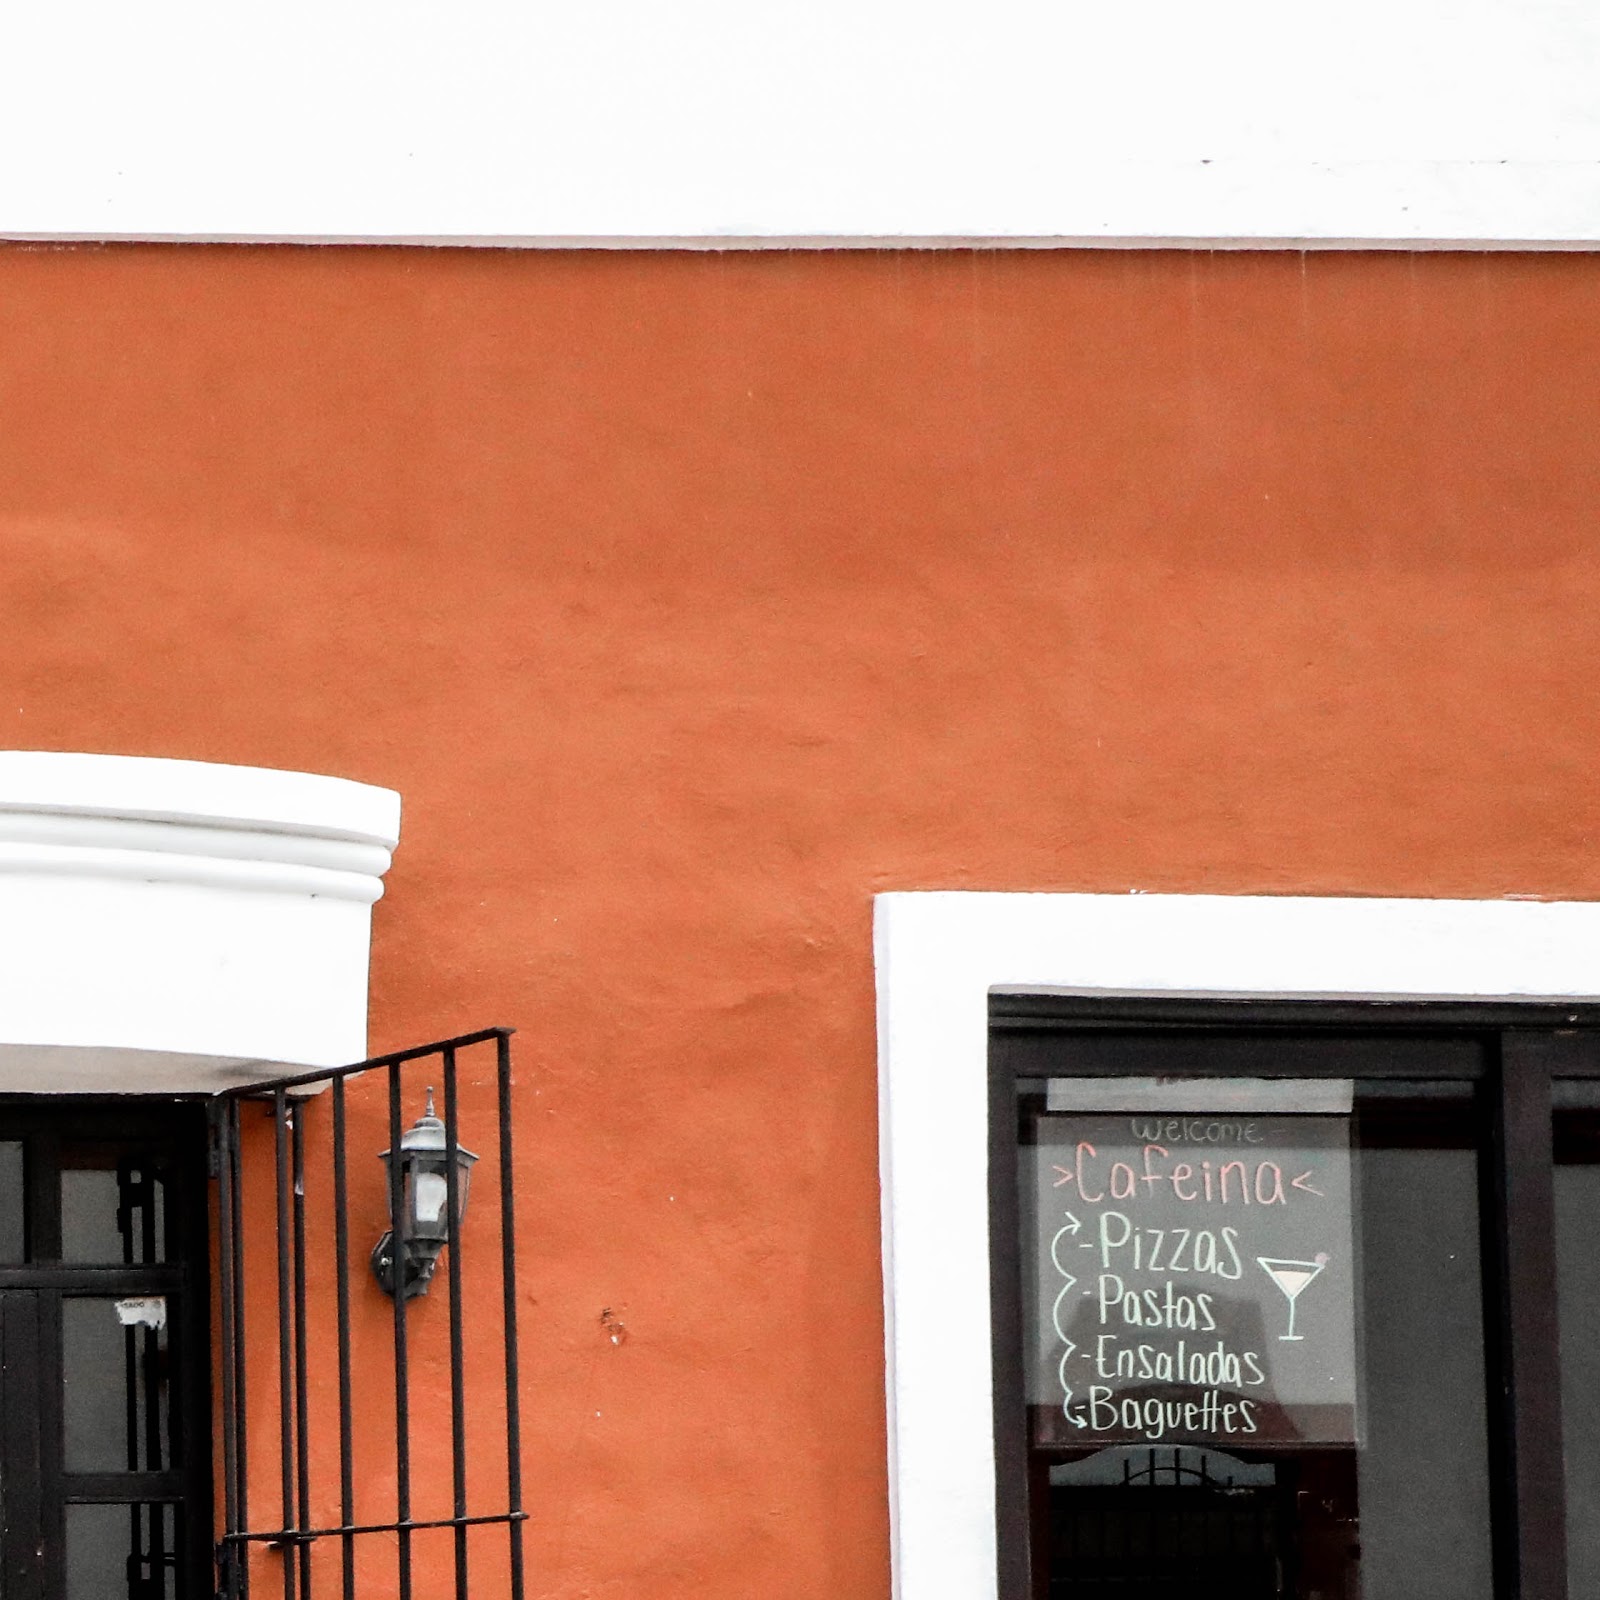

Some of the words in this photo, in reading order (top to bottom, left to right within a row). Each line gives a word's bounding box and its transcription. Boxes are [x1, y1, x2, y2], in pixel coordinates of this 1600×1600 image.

[1101, 1211, 1242, 1280] Pizzas
[1099, 1274, 1216, 1331] Pastas
[1096, 1335, 1265, 1388] Ensaladas
[1089, 1385, 1258, 1439] Baguettes
